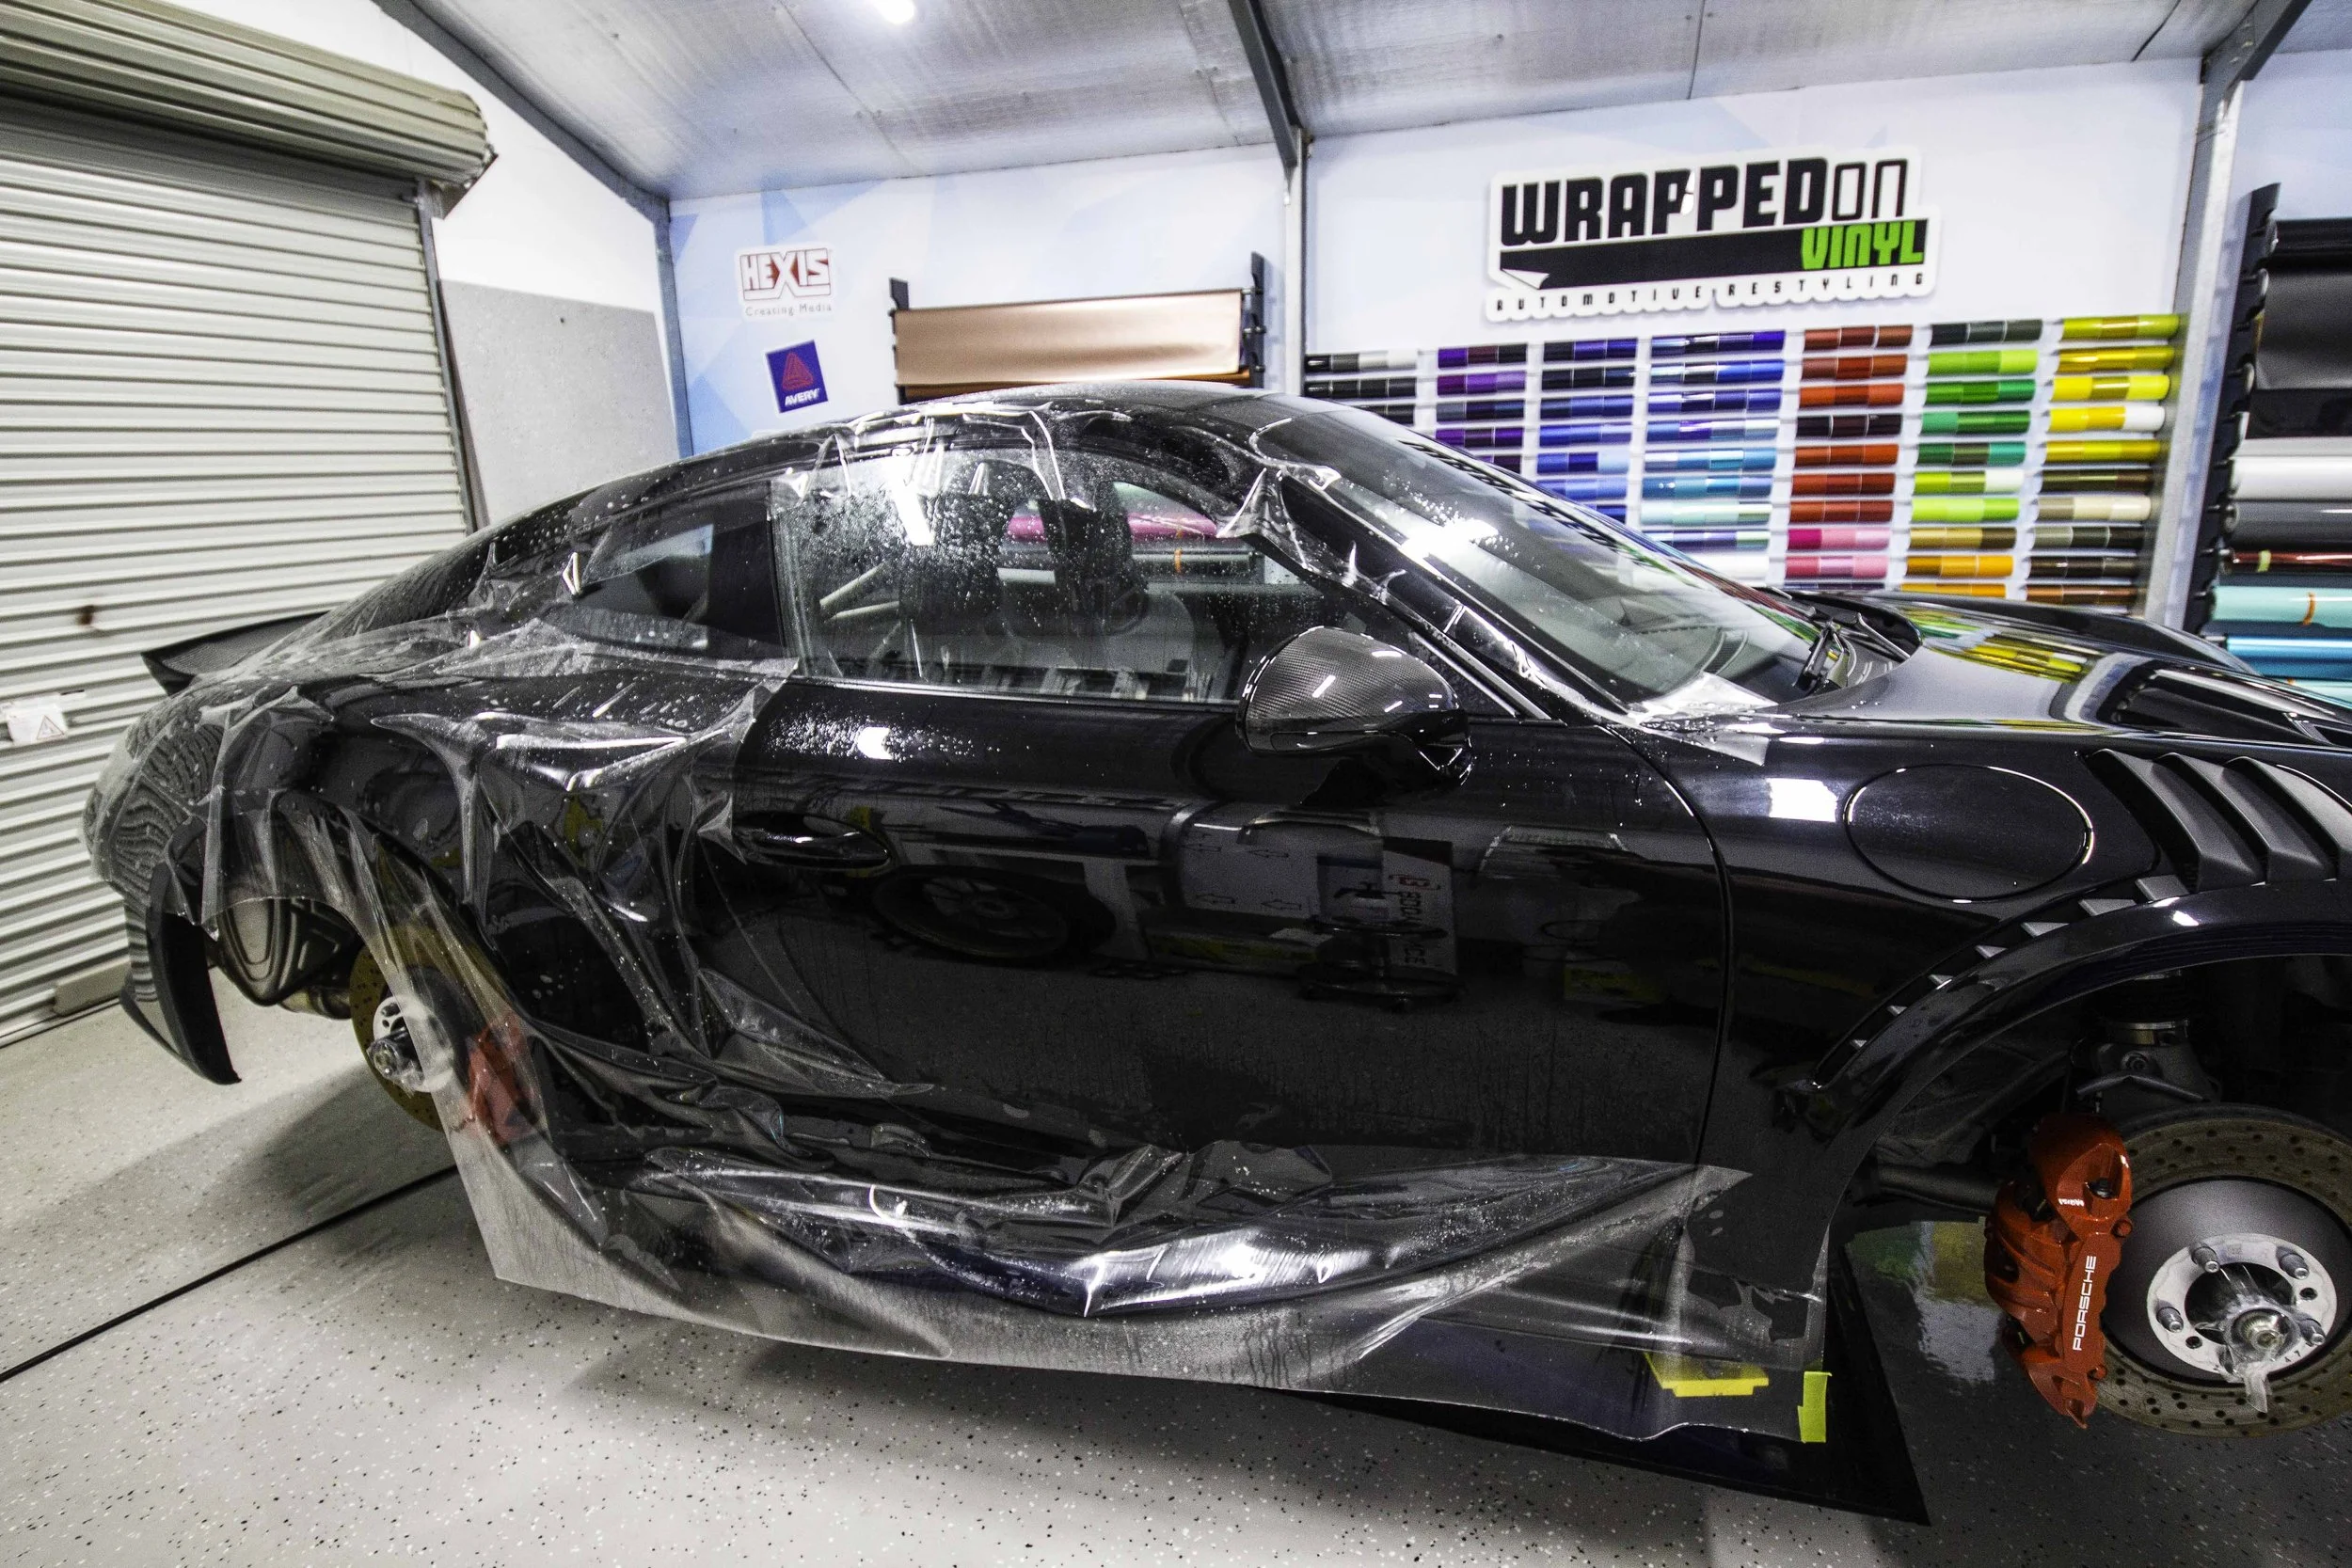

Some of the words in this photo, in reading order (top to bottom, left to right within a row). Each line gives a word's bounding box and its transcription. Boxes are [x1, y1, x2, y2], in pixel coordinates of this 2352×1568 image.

[1801, 220, 1924, 271] VINYL
[740, 248, 831, 300] HEXIS
[1497, 286, 1701, 311] AUTOMOTIVE
[1728, 273, 1923, 296] RESTYLING
[745, 306, 794, 317] Creating
[800, 304, 832, 312] Media
[785, 388, 819, 405] AVERY
[2073, 1256, 2097, 1351] PORSCHE
